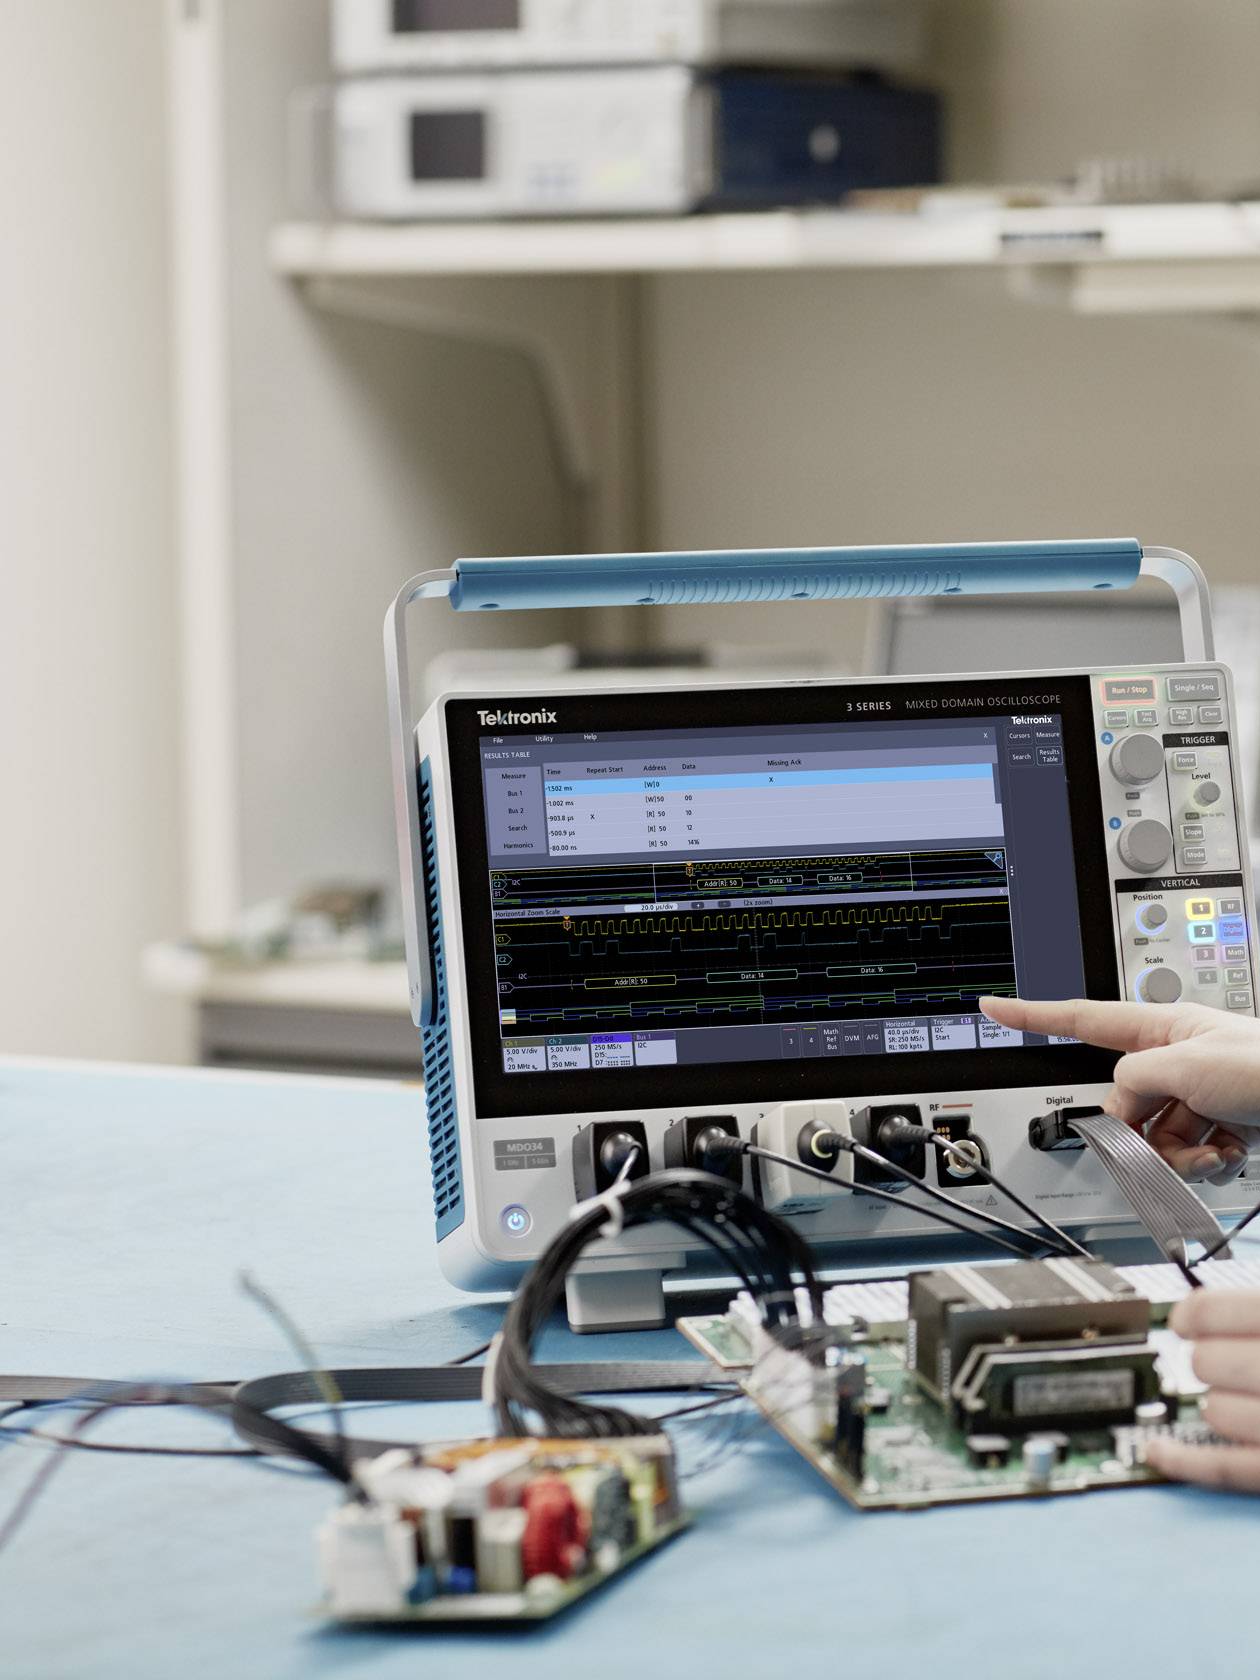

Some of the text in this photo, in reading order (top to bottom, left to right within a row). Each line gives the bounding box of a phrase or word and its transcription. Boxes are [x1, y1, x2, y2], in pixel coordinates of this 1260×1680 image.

[1112, 686, 1148, 694] Run Stop
[1174, 684, 1214, 692] Single Seq
[846, 701, 892, 712] 3 SERIES
[906, 695, 1061, 710] MIXED DOMAIN OSCILLOSCOPE
[477, 708, 557, 726] Tektronix
[1011, 715, 1052, 725] Tektronix
[1009, 732, 1030, 740] Cursors
[1036, 730, 1060, 738] Measure
[1181, 736, 1216, 744] TRIGGER
[484, 752, 510, 760] RESULTS
[1040, 748, 1060, 756] Results
[1012, 752, 1032, 761] Search
[768, 758, 802, 767] Missing Ack
[643, 764, 666, 772] Address
[502, 772, 526, 780] Measure
[508, 824, 528, 832] Search
[504, 842, 534, 850] Harmonics
[1161, 879, 1200, 888] VERTICAL
[1200, 904, 1204, 912] 1
[496, 910, 526, 918] Horizontal
[1204, 950, 1208, 958] 3
[1144, 956, 1164, 964] Scale
[740, 972, 756, 980] Data:
[934, 1018, 954, 1026] Trigger
[982, 1031, 1000, 1039] Single:
[1046, 1096, 1074, 1106] Digital
[506, 1142, 544, 1152] MDO34
